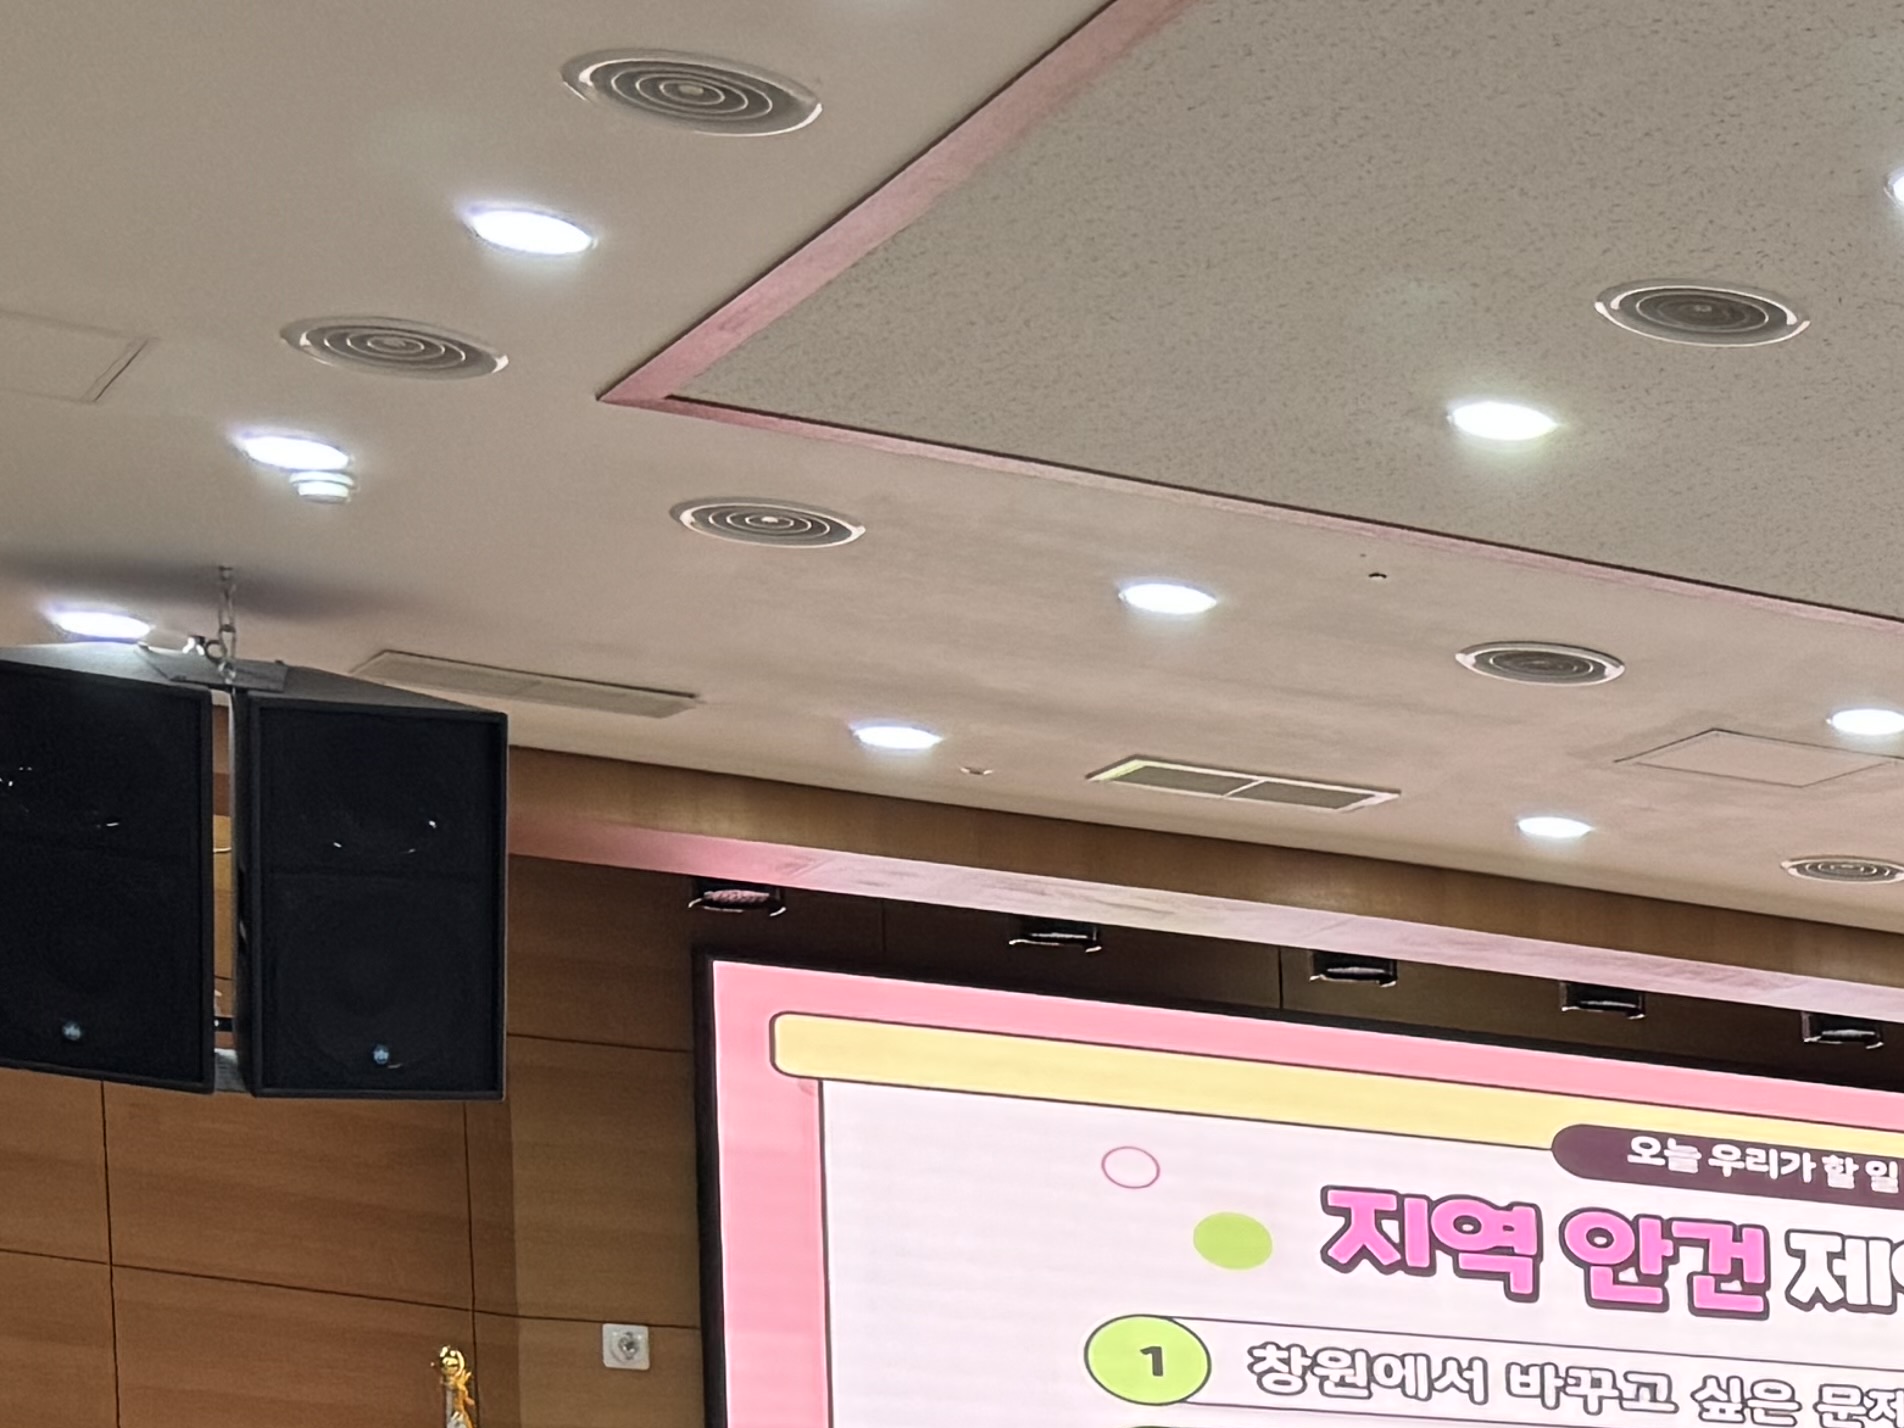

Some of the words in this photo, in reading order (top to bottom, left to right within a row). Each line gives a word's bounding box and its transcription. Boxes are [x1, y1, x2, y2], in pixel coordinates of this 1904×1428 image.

[1627, 1135, 1702, 1173] 오늘
[1708, 1143, 1816, 1183] 우리가
[1822, 1154, 1860, 1189] 할
[1865, 1160, 1899, 1194] 일
[1321, 1185, 1543, 1301] 지역
[1560, 1206, 1769, 1320] 안건
[1140, 1345, 1164, 1377] 1
[1247, 1341, 1489, 1405] 창원에서
[1505, 1361, 1680, 1416] 바꾸고
[1691, 1375, 1802, 1428] 싶은
